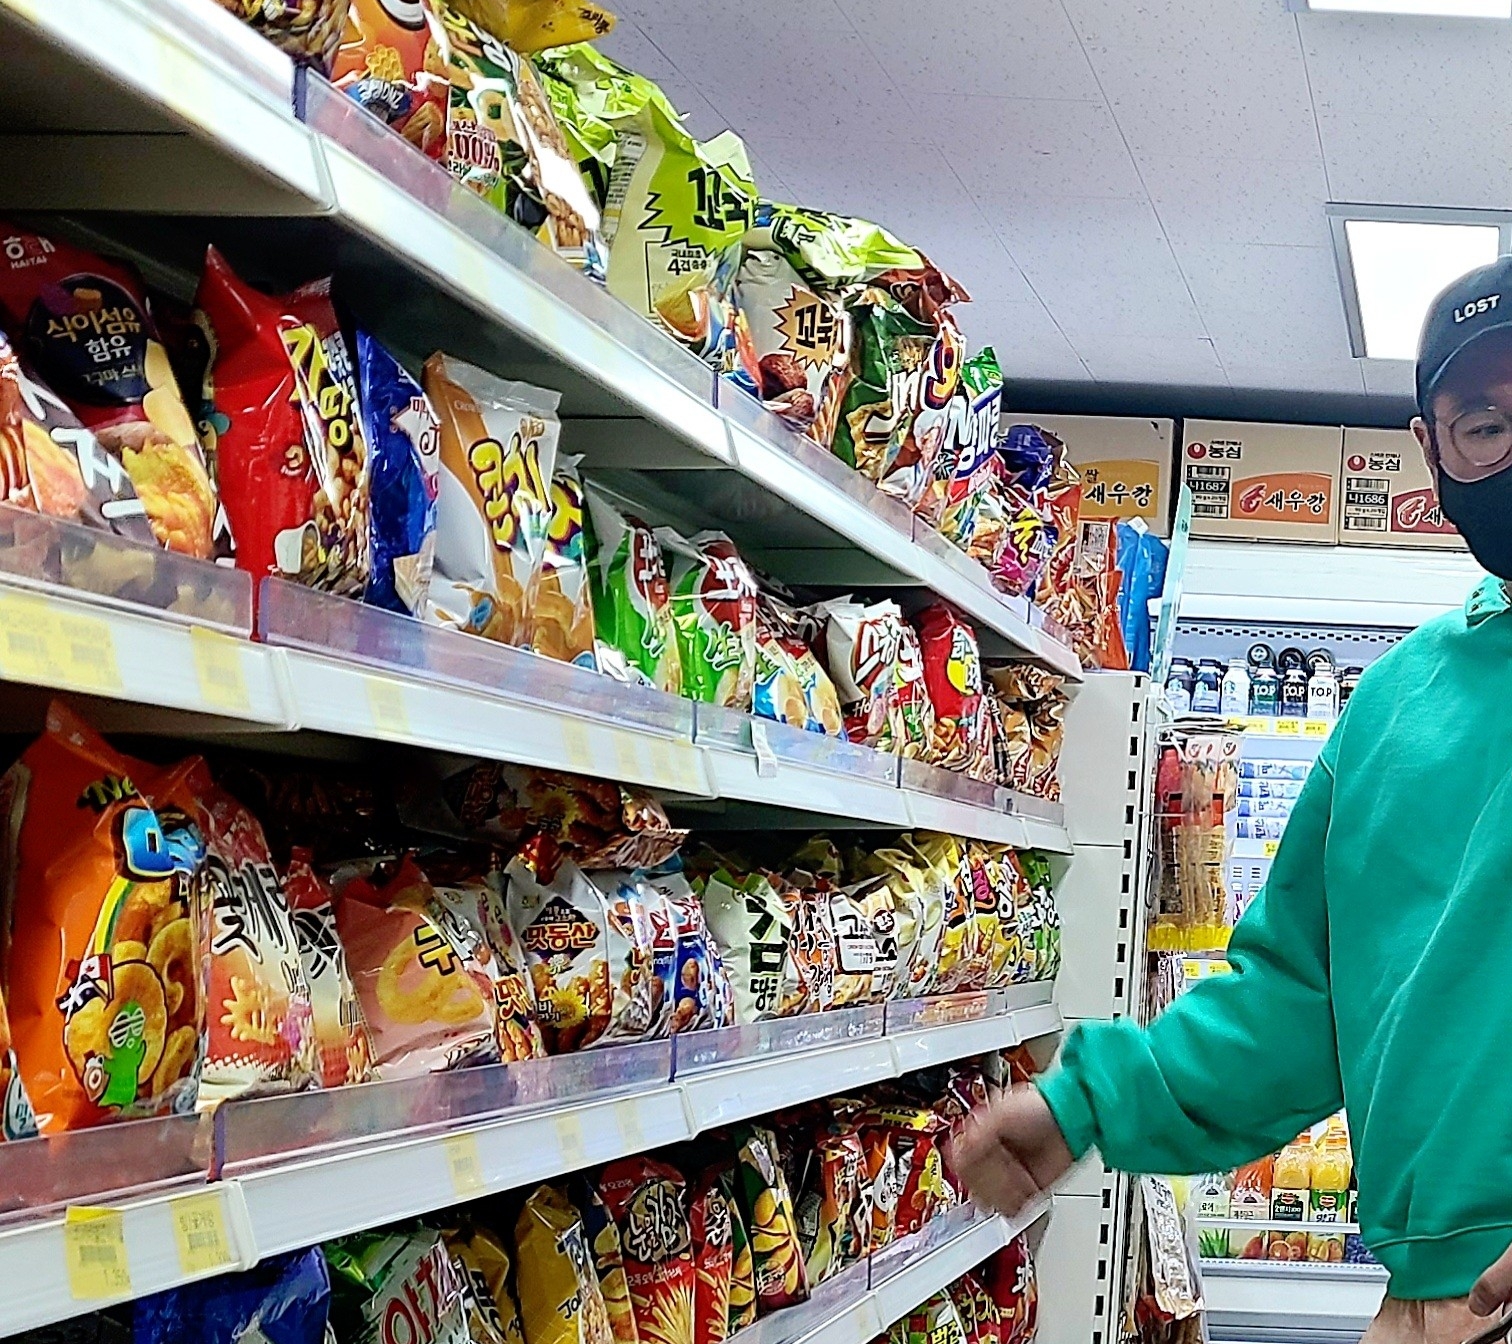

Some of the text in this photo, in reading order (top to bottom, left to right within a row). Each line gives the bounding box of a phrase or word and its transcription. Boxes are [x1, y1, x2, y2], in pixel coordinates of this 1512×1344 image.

[1453, 294, 1501, 323] LOST
[45, 307, 142, 340] 식이섬유
[84, 336, 134, 363] 함유
[1208, 445, 1242, 460] 농심
[1368, 457, 1401, 471] 농심
[1085, 468, 1100, 483] 쌀
[1085, 482, 1153, 508] 새우깡
[1264, 491, 1326, 514] 새우깡
[525, 920, 599, 953] 맛동산
